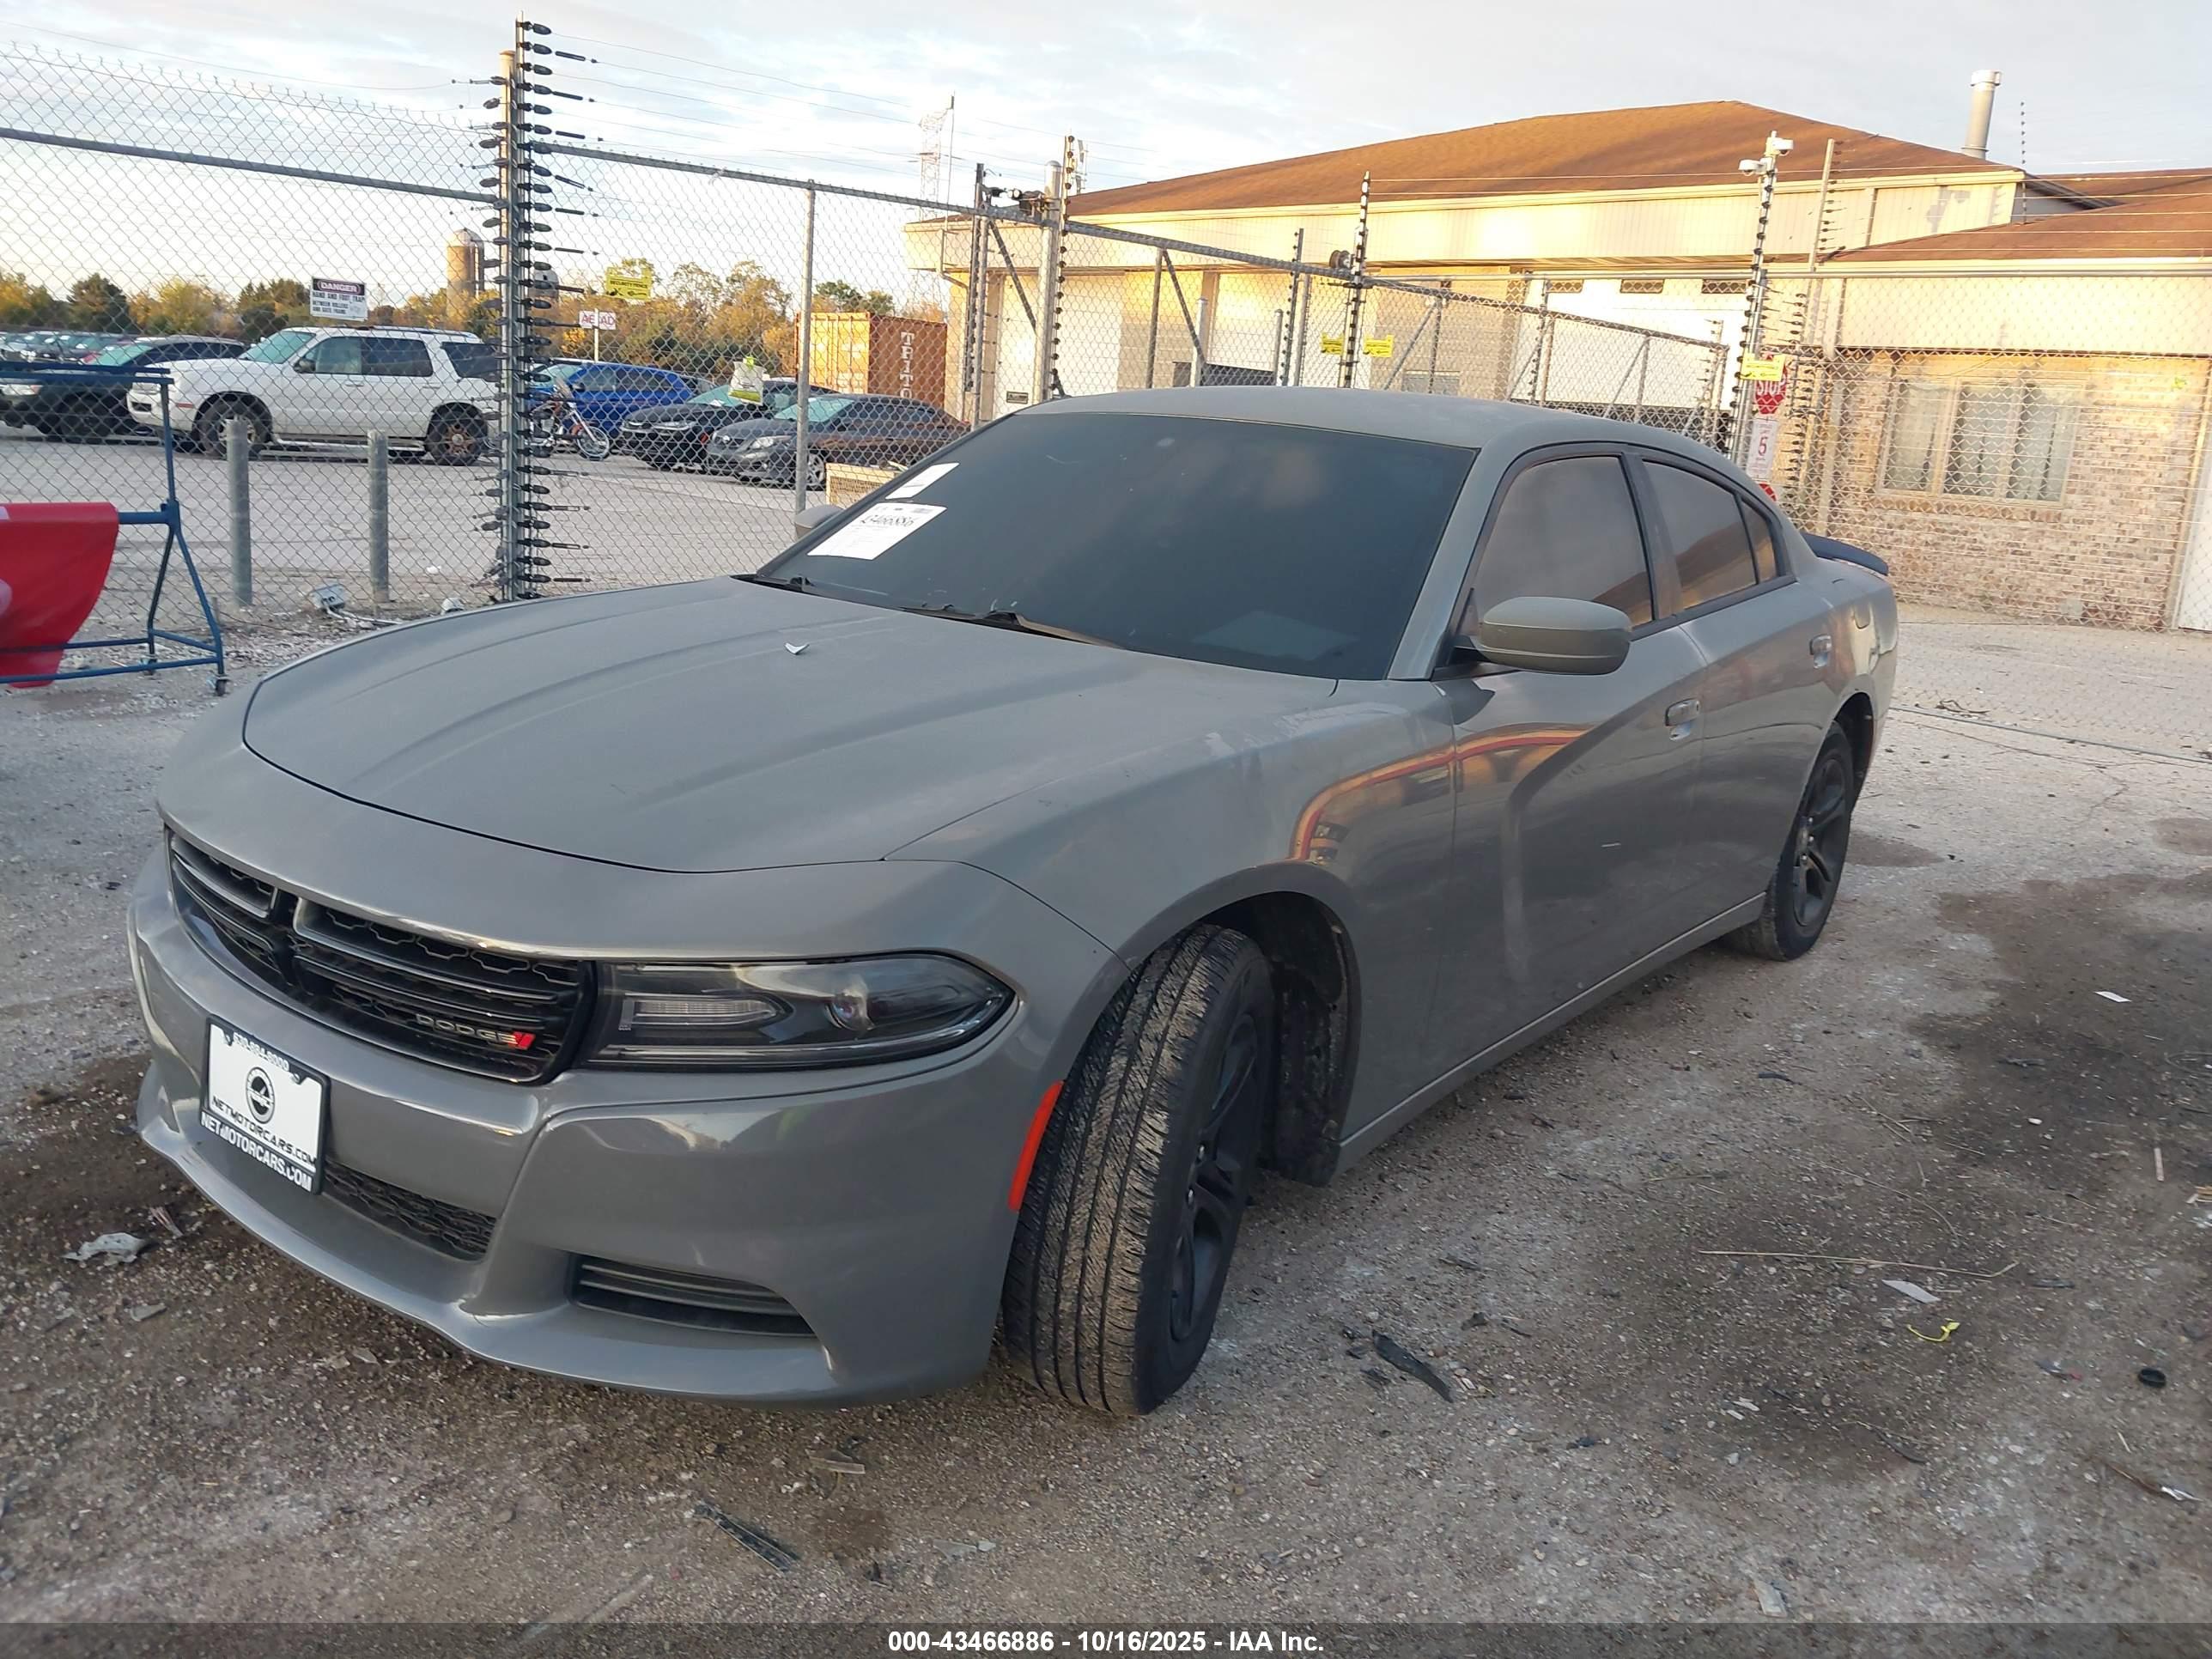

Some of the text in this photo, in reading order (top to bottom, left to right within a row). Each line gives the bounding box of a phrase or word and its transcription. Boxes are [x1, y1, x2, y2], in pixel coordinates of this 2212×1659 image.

[320, 282, 357, 292] DANGER
[1757, 373, 1787, 396] STOP
[1759, 436, 1768, 456] 5
[416, 1013, 519, 1044] DODGE
[211, 1096, 317, 1166] NETMOTORCARS.COM
